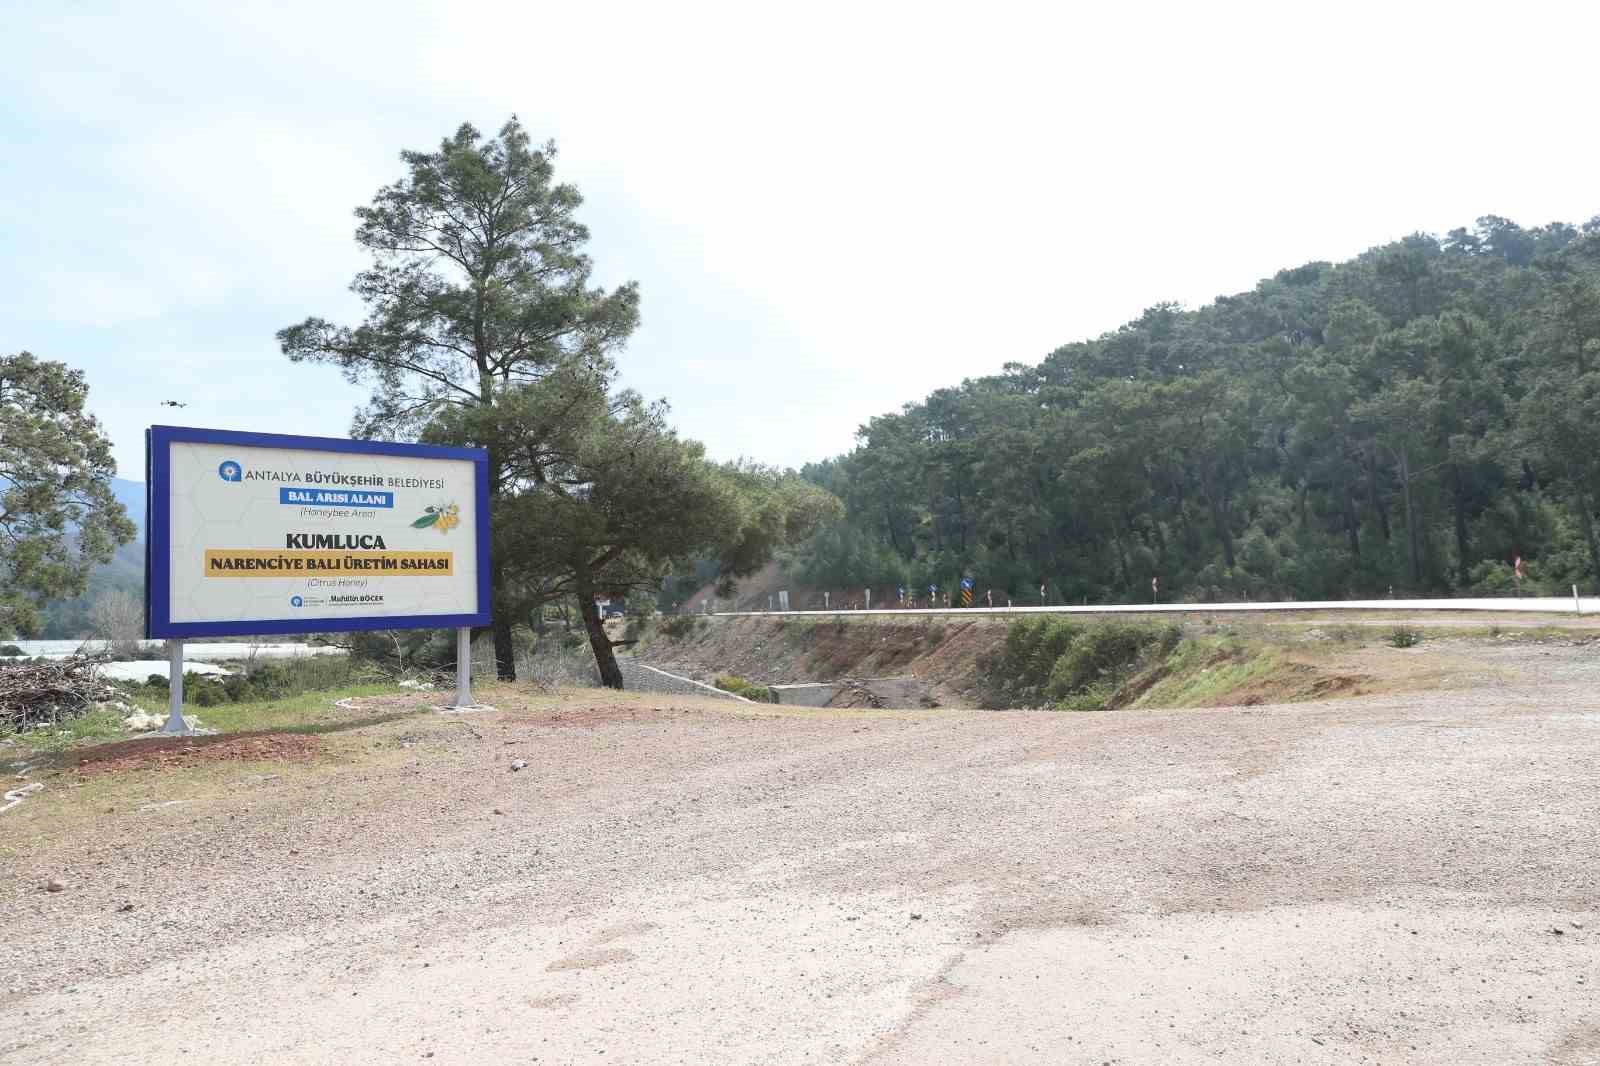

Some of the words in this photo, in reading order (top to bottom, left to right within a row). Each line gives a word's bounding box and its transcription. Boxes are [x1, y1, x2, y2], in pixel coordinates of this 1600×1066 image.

[245, 469, 301, 483] ANTALYA
[305, 470, 384, 488] BÜYÜKŞEHİR
[288, 490, 313, 503] BAL
[316, 492, 349, 504] ARISI
[350, 494, 386, 505] ALANI
[299, 507, 349, 520] (Honeybee
[286, 533, 386, 549] KUMLUCA
[210, 555, 302, 570] NARENCİYE
[306, 558, 341, 570] BALI
[343, 556, 398, 570] ÜRETİM
[400, 558, 449, 570] SAHASI
[307, 577, 336, 588] (Citrus
[338, 578, 368, 588] Honey)
